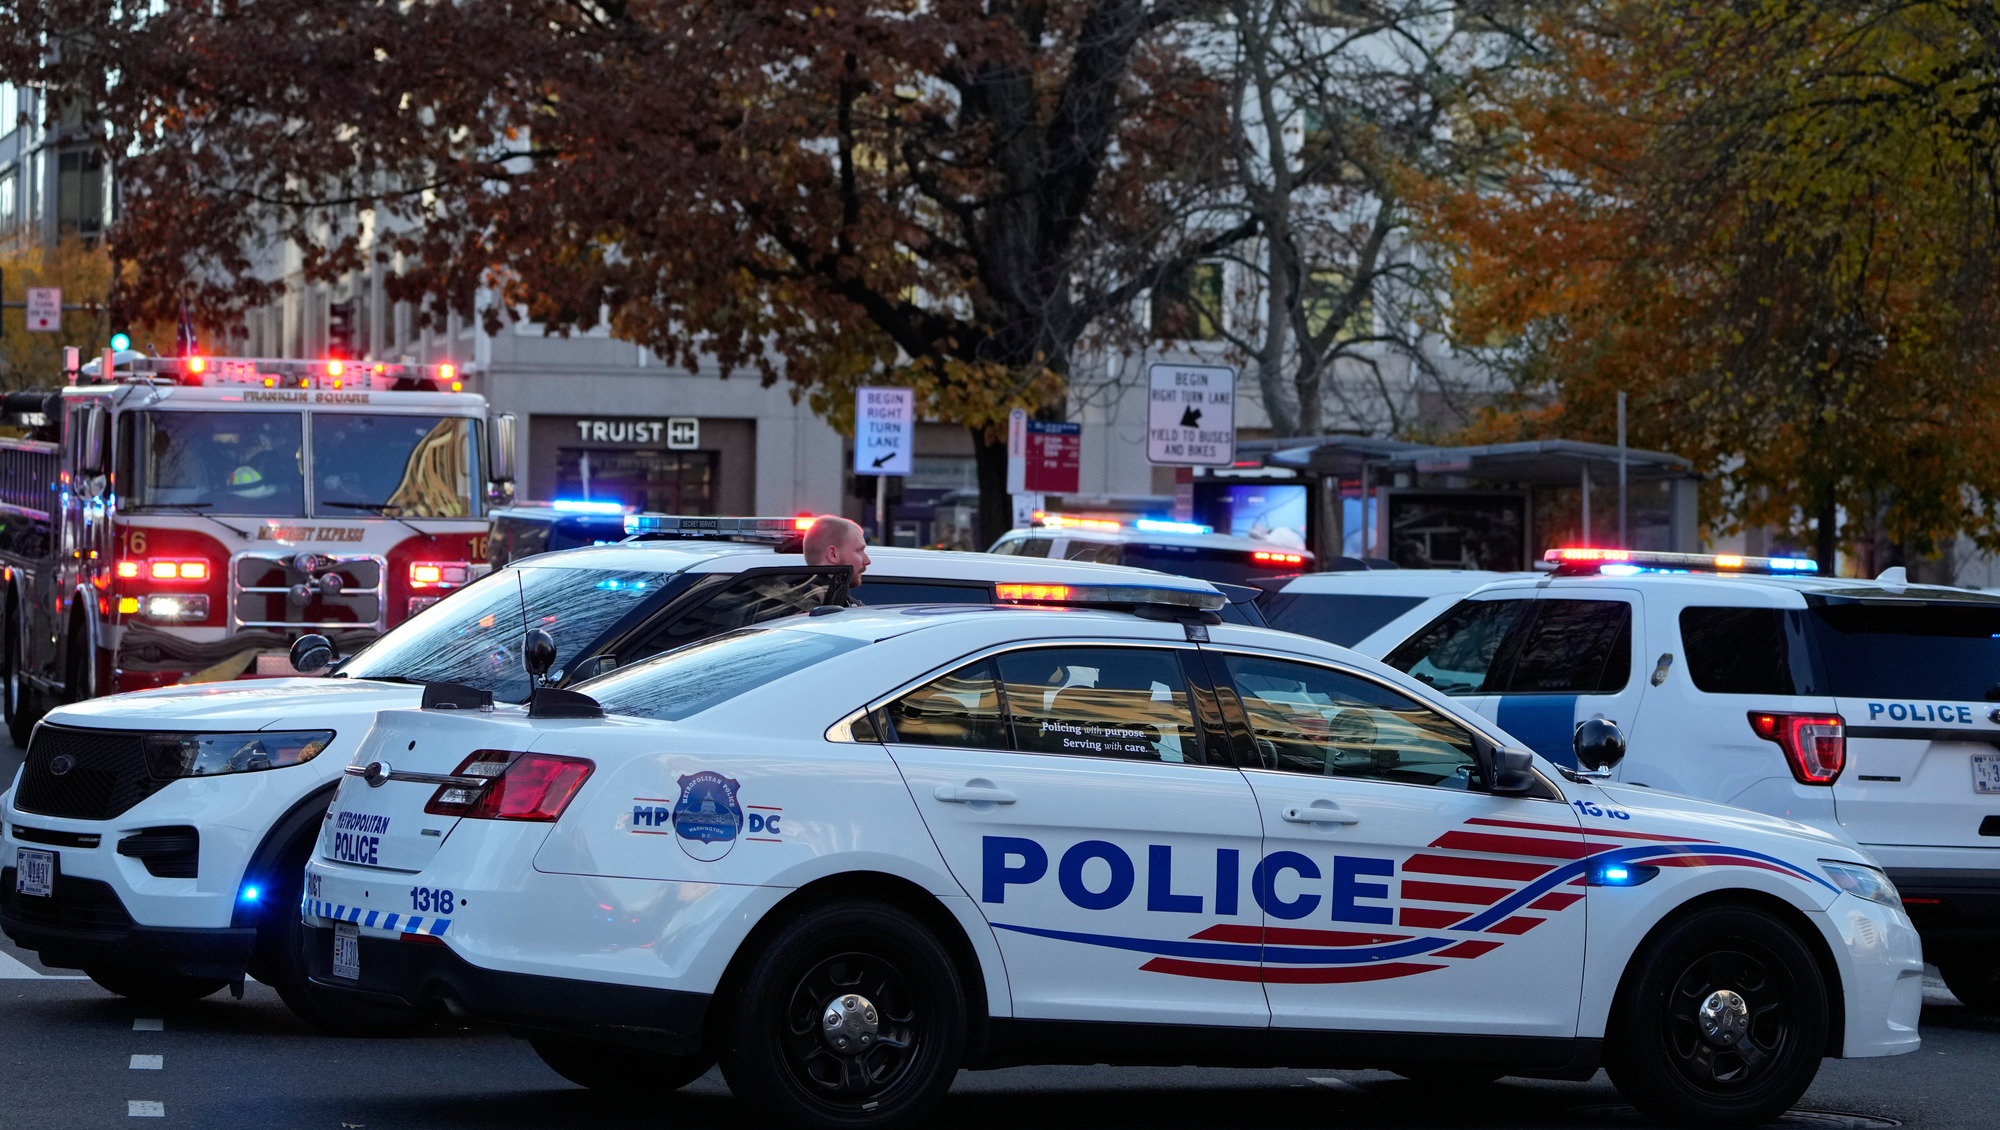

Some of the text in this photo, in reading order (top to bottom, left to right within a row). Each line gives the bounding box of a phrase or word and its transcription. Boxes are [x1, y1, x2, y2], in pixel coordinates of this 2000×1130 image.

[1175, 372, 1208, 386] BEGIN
[243, 391, 369, 403] FRANKLIN SQUARE
[867, 393, 904, 405] BEGIN
[1152, 389, 1230, 405] RIGHT TURN LANE
[867, 407, 902, 419] RIGHT
[577, 421, 664, 442] TRUIST
[870, 422, 901, 433] TURN
[867, 437, 900, 448] LANE
[1151, 429, 1231, 443] YIELD TO BUSES
[1164, 444, 1216, 457] AND BIKES
[315, 527, 365, 542] EXPRESS
[468, 536, 489, 559] 16
[1868, 703, 1973, 724] POLICE
[1041, 721, 1147, 738] Policing with purpose.
[1063, 738, 1148, 753] Serving with care.
[682, 775, 735, 808] METROPOLITAN POLICE
[335, 811, 390, 835] METROPOLITAN
[633, 805, 781, 834] MP DC
[688, 826, 725, 835] WASHINGTON
[334, 832, 379, 865] POLICE
[981, 835, 1395, 925] POLICE
[410, 887, 454, 914] 1318
